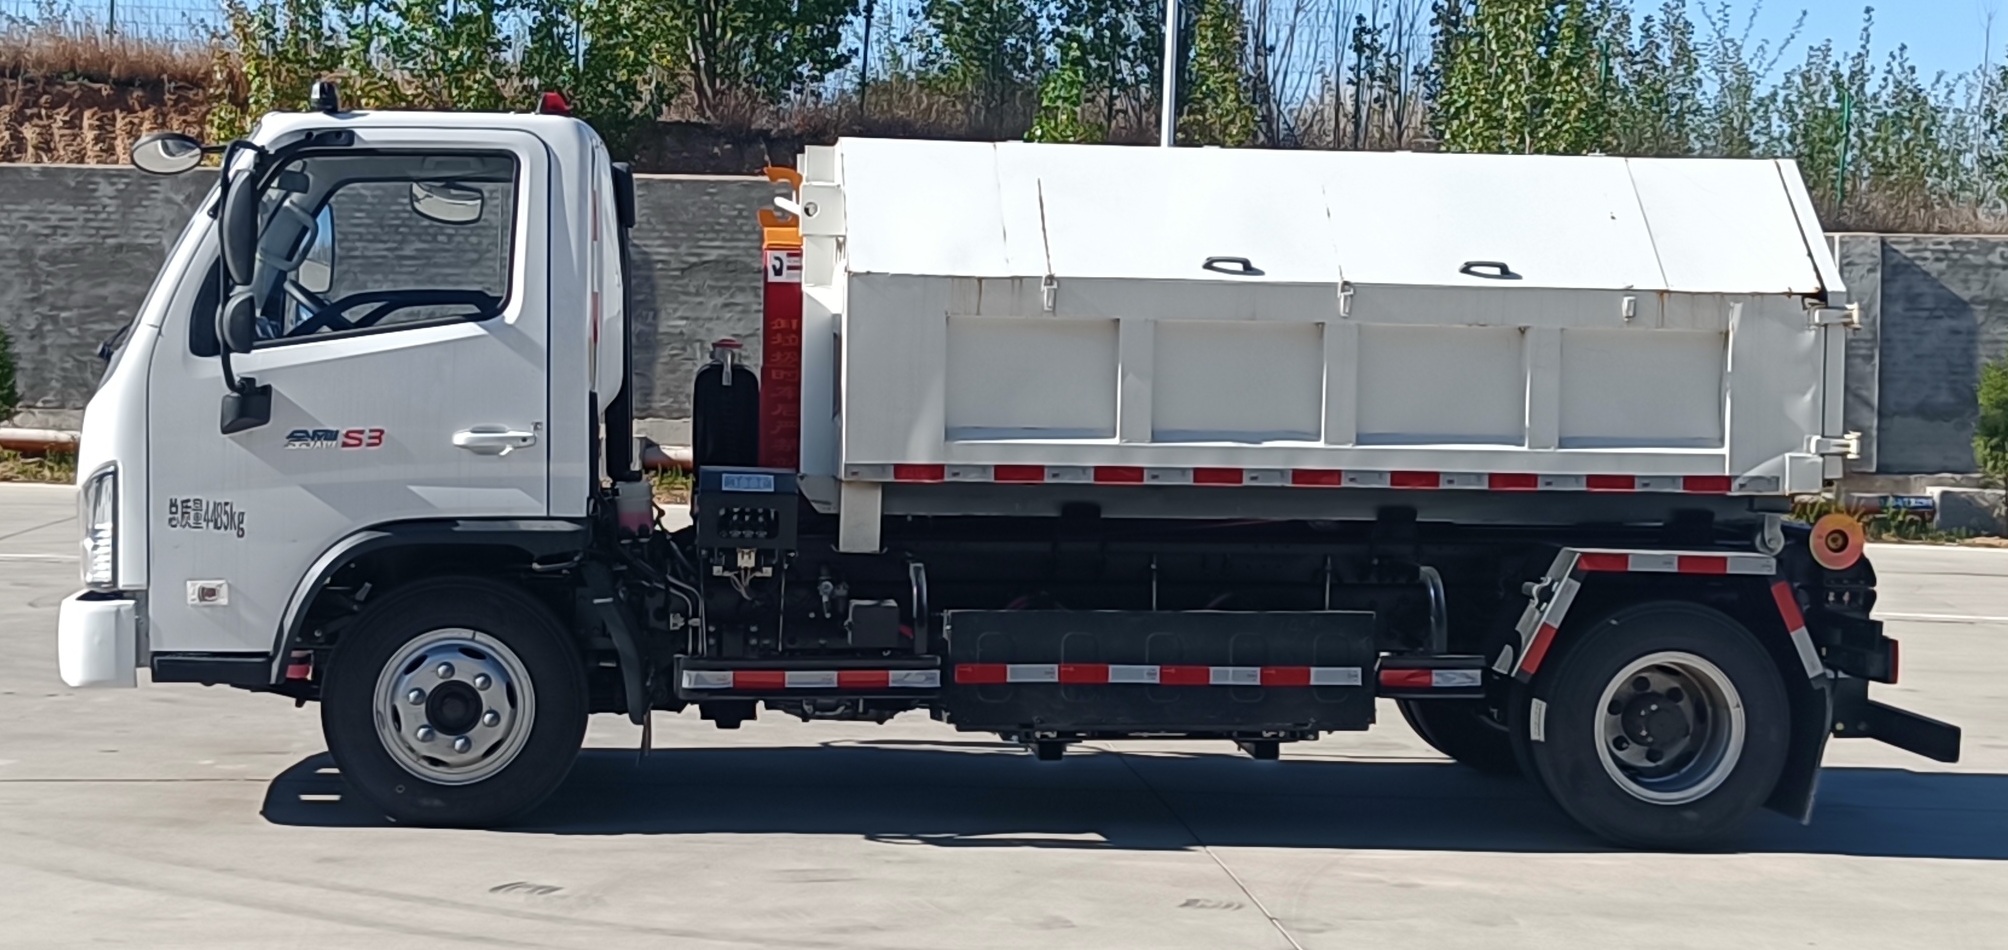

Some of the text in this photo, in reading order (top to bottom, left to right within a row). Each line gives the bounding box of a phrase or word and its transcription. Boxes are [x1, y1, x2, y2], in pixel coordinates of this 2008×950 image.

[341, 429, 385, 448] S3
[168, 498, 245, 539] 总质量4485kg
